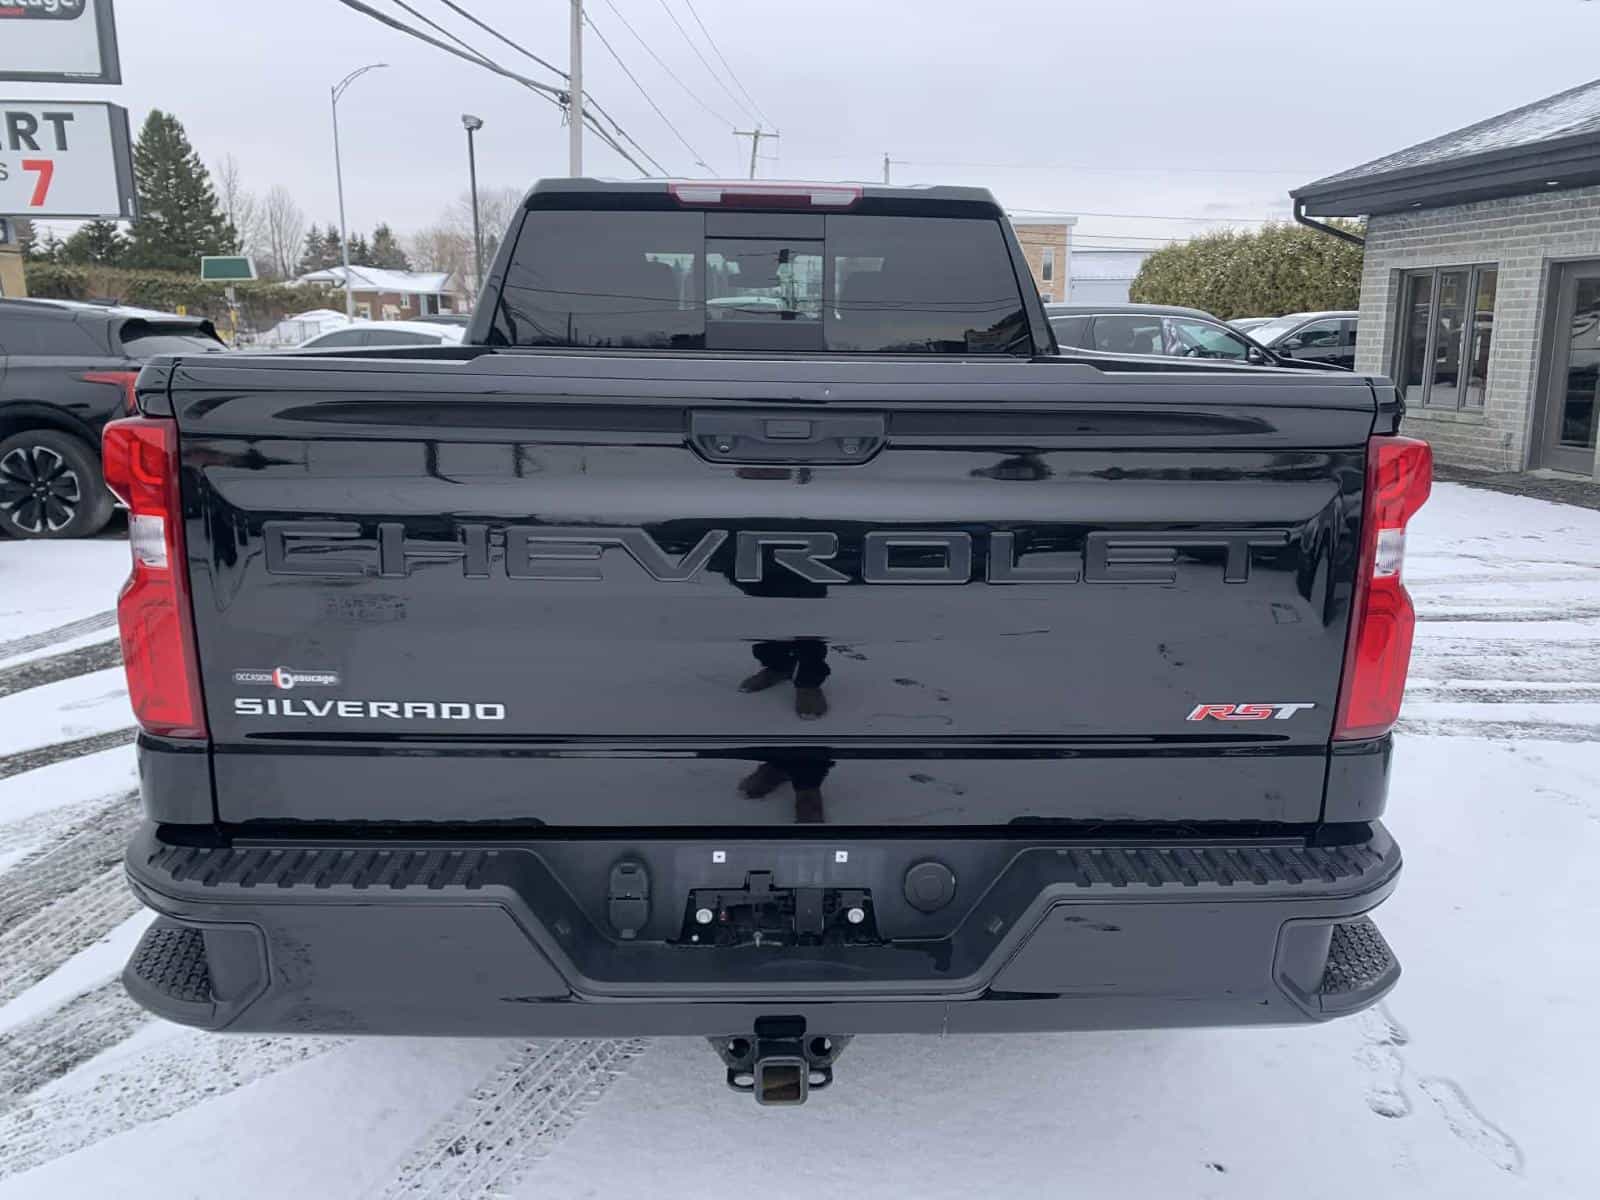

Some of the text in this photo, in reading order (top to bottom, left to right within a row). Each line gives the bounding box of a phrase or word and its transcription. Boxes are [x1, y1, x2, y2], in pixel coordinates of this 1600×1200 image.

[0, 111, 75, 151] RT
[22, 160, 54, 207] 7
[263, 520, 1291, 585] CHEVROLET
[234, 698, 506, 721] SILVERADO
[1186, 703, 1316, 721] RST
